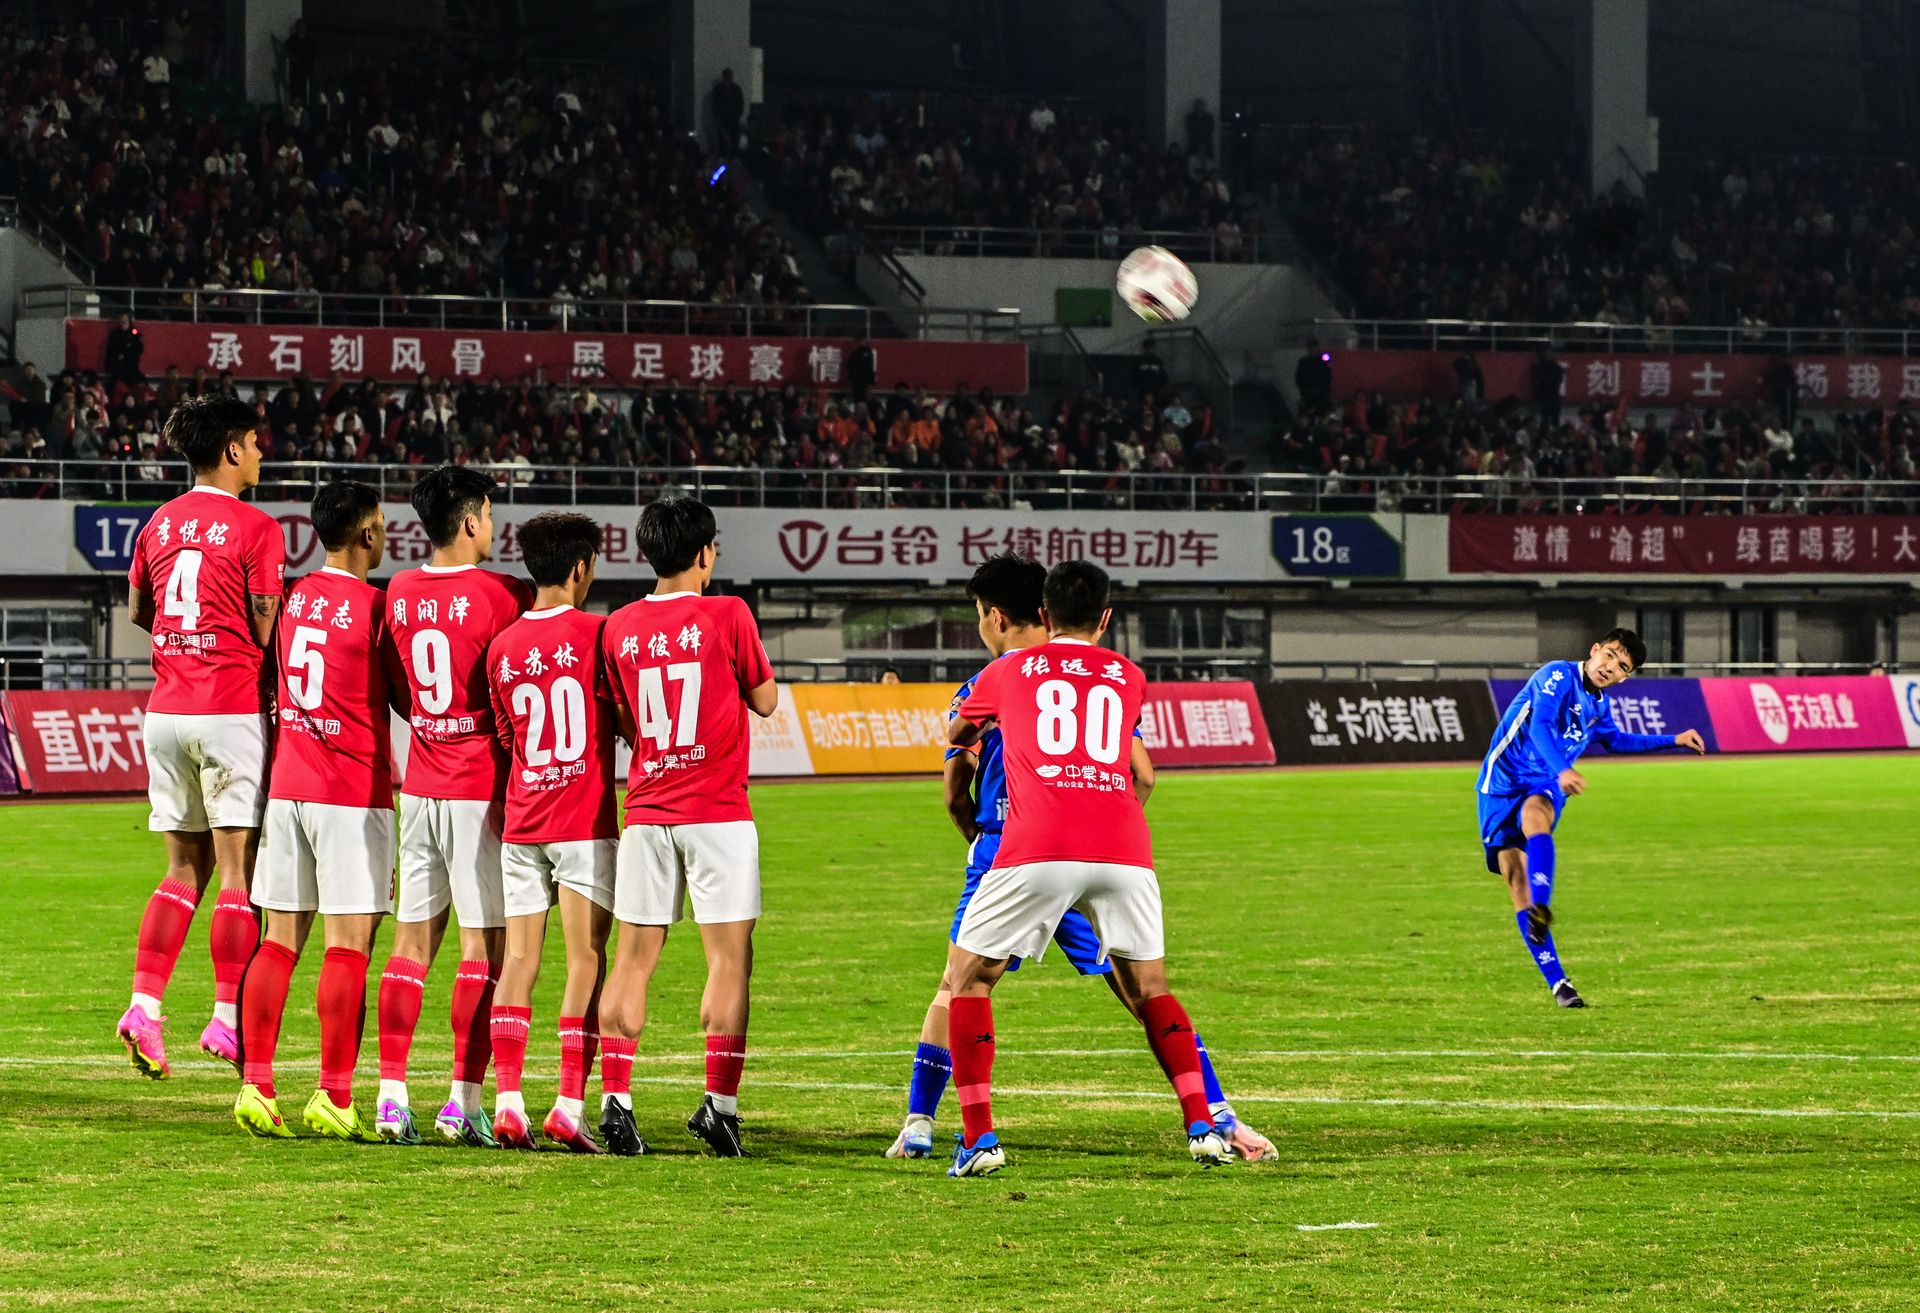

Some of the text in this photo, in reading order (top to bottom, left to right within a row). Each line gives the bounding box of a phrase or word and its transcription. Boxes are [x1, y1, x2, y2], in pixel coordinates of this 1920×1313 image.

[95, 517, 139, 557] 17
[157, 517, 229, 546] 李悦铭
[837, 525, 1219, 568] 台铃 长续航电动车
[164, 550, 202, 631] 4
[287, 591, 353, 629] 谢宏志
[393, 595, 471, 626] 周润泽
[500, 642, 579, 683] 秦苏林
[619, 623, 702, 664] 邱俊锋
[287, 625, 328, 711] 5
[411, 628, 453, 715] 9
[511, 675, 587, 767] 20
[638, 661, 702, 750] 47
[1036, 679, 1123, 764] 80
[1336, 696, 1465, 745] 卡尔美体育
[1786, 693, 1859, 730] 天友乳业
[806, 708, 949, 748] 助85万亩盐碱地
